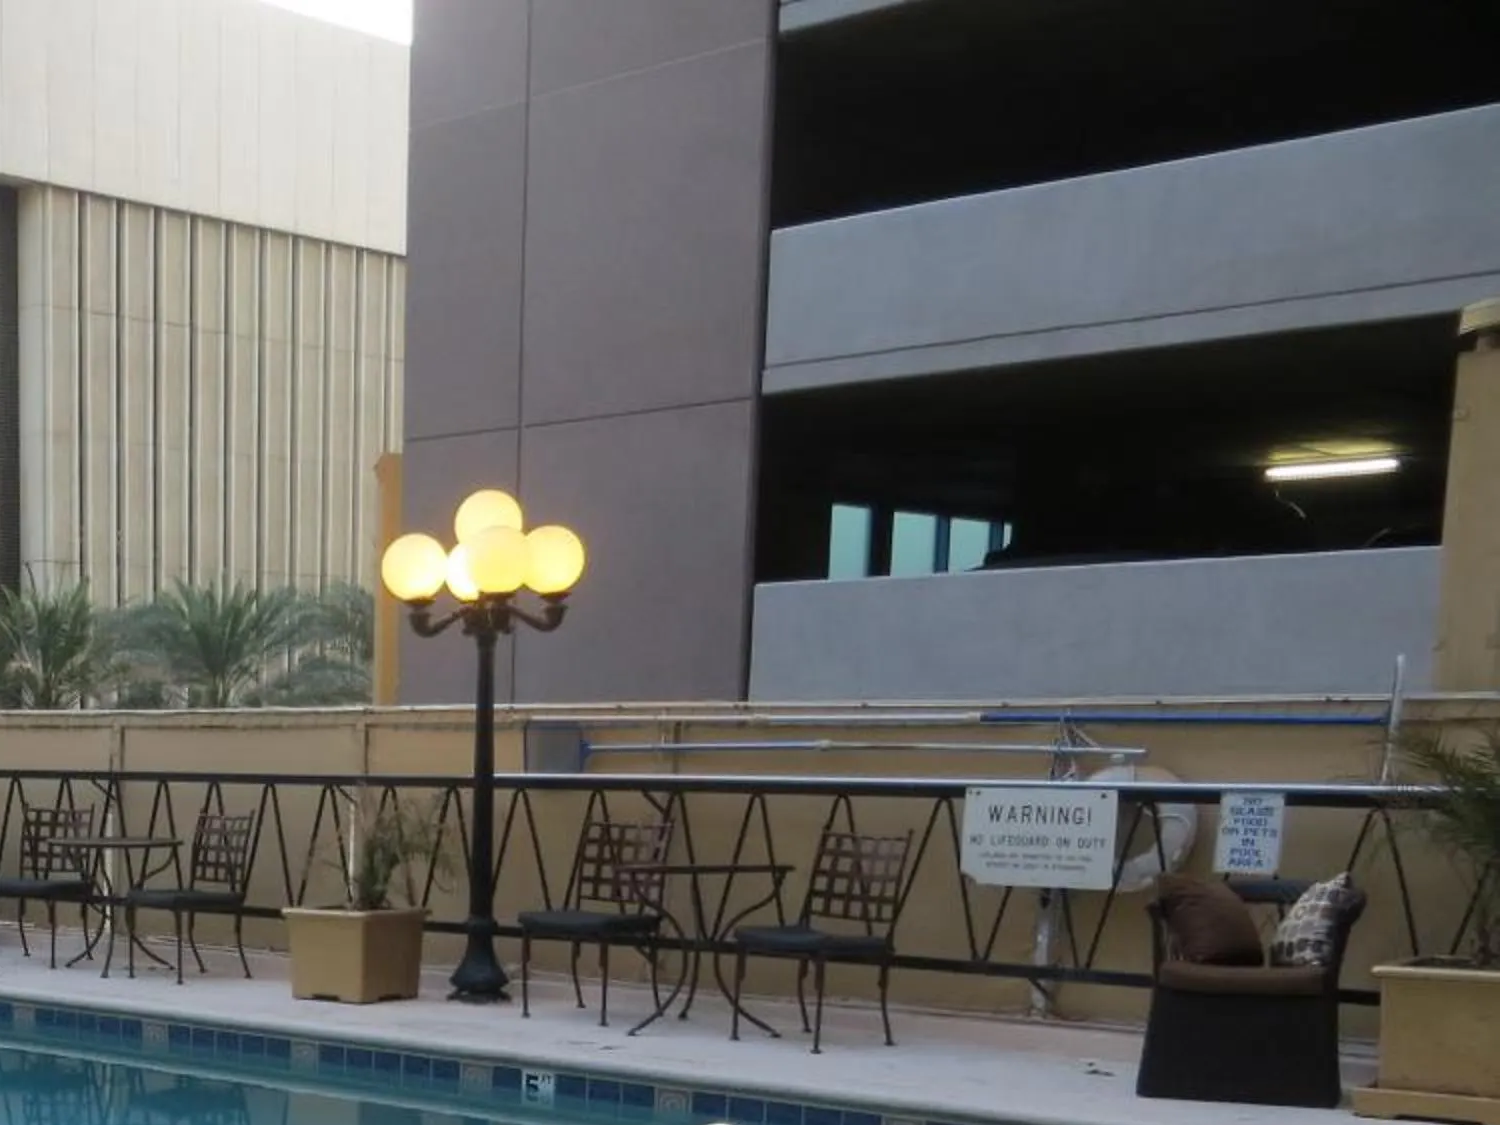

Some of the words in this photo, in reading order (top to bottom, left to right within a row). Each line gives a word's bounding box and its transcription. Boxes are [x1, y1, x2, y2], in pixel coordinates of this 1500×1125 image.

[988, 804, 1092, 826] WARNING!
[969, 833, 983, 845] NO
[990, 833, 1049, 848] LIFEGUARD
[1056, 836, 1070, 848] ON
[1077, 836, 1107, 849] DUTY
